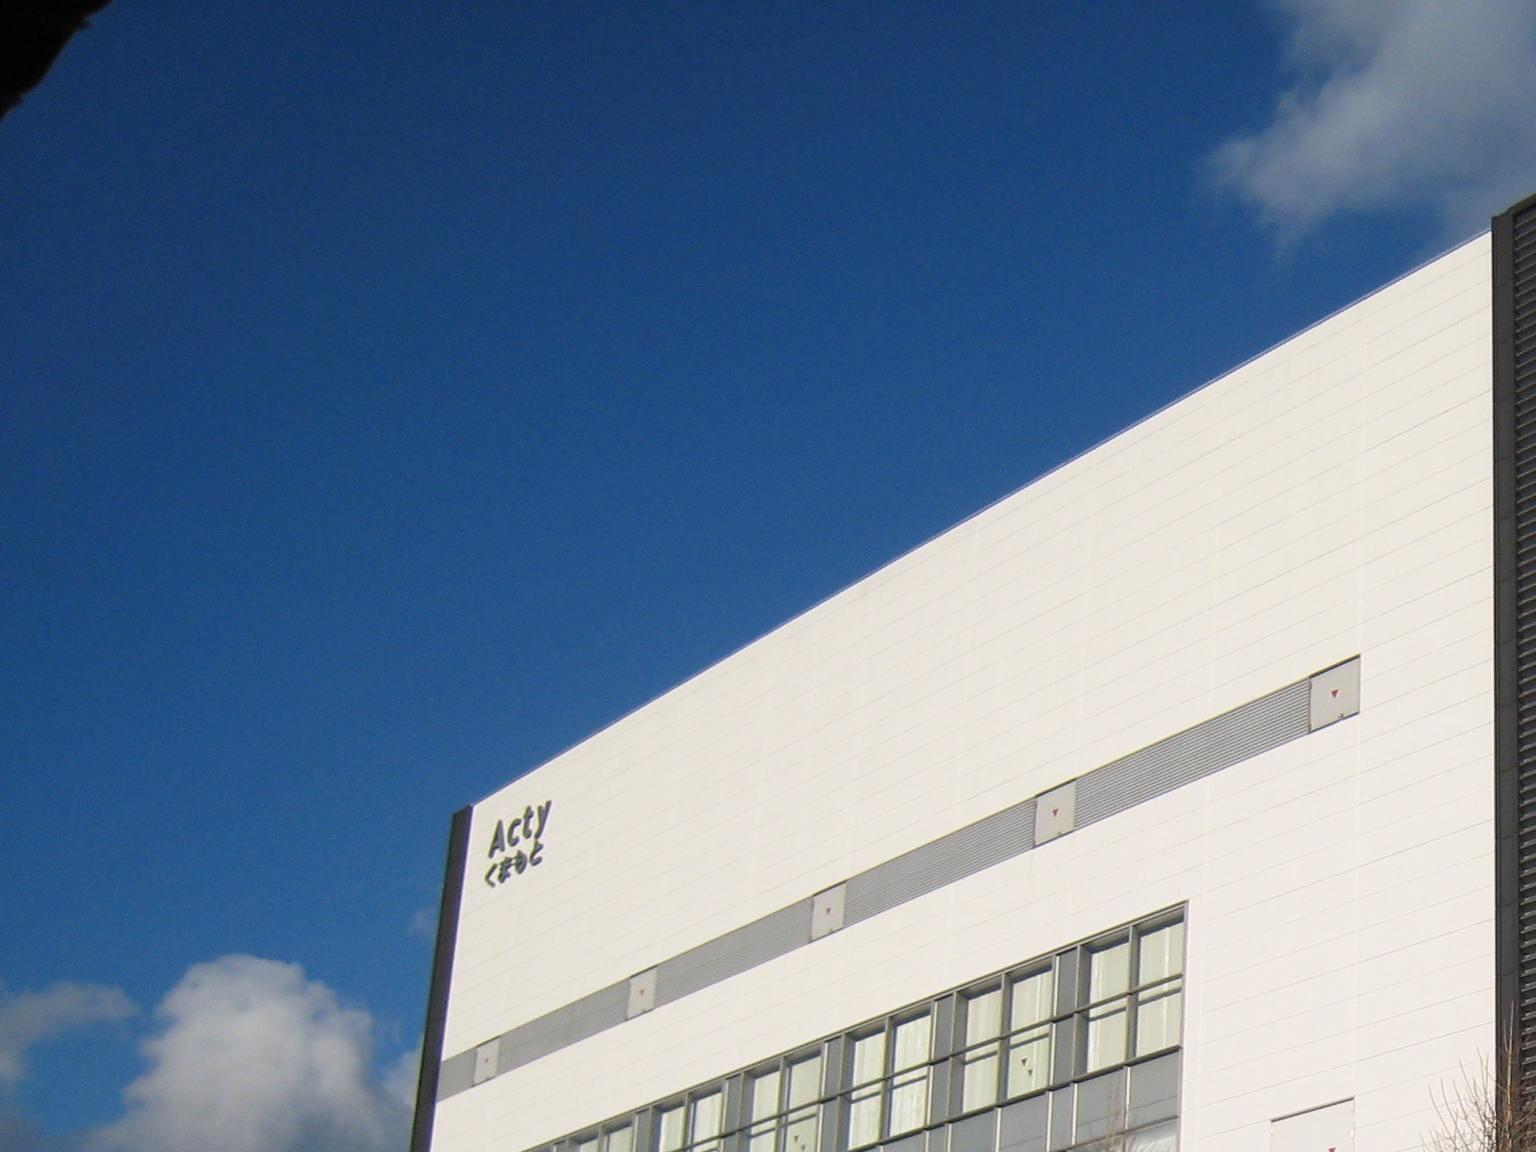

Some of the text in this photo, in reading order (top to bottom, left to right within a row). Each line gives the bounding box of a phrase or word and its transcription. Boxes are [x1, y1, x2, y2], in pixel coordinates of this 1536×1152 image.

[488, 800, 552, 857] Acty
[485, 840, 544, 887] くまもと
